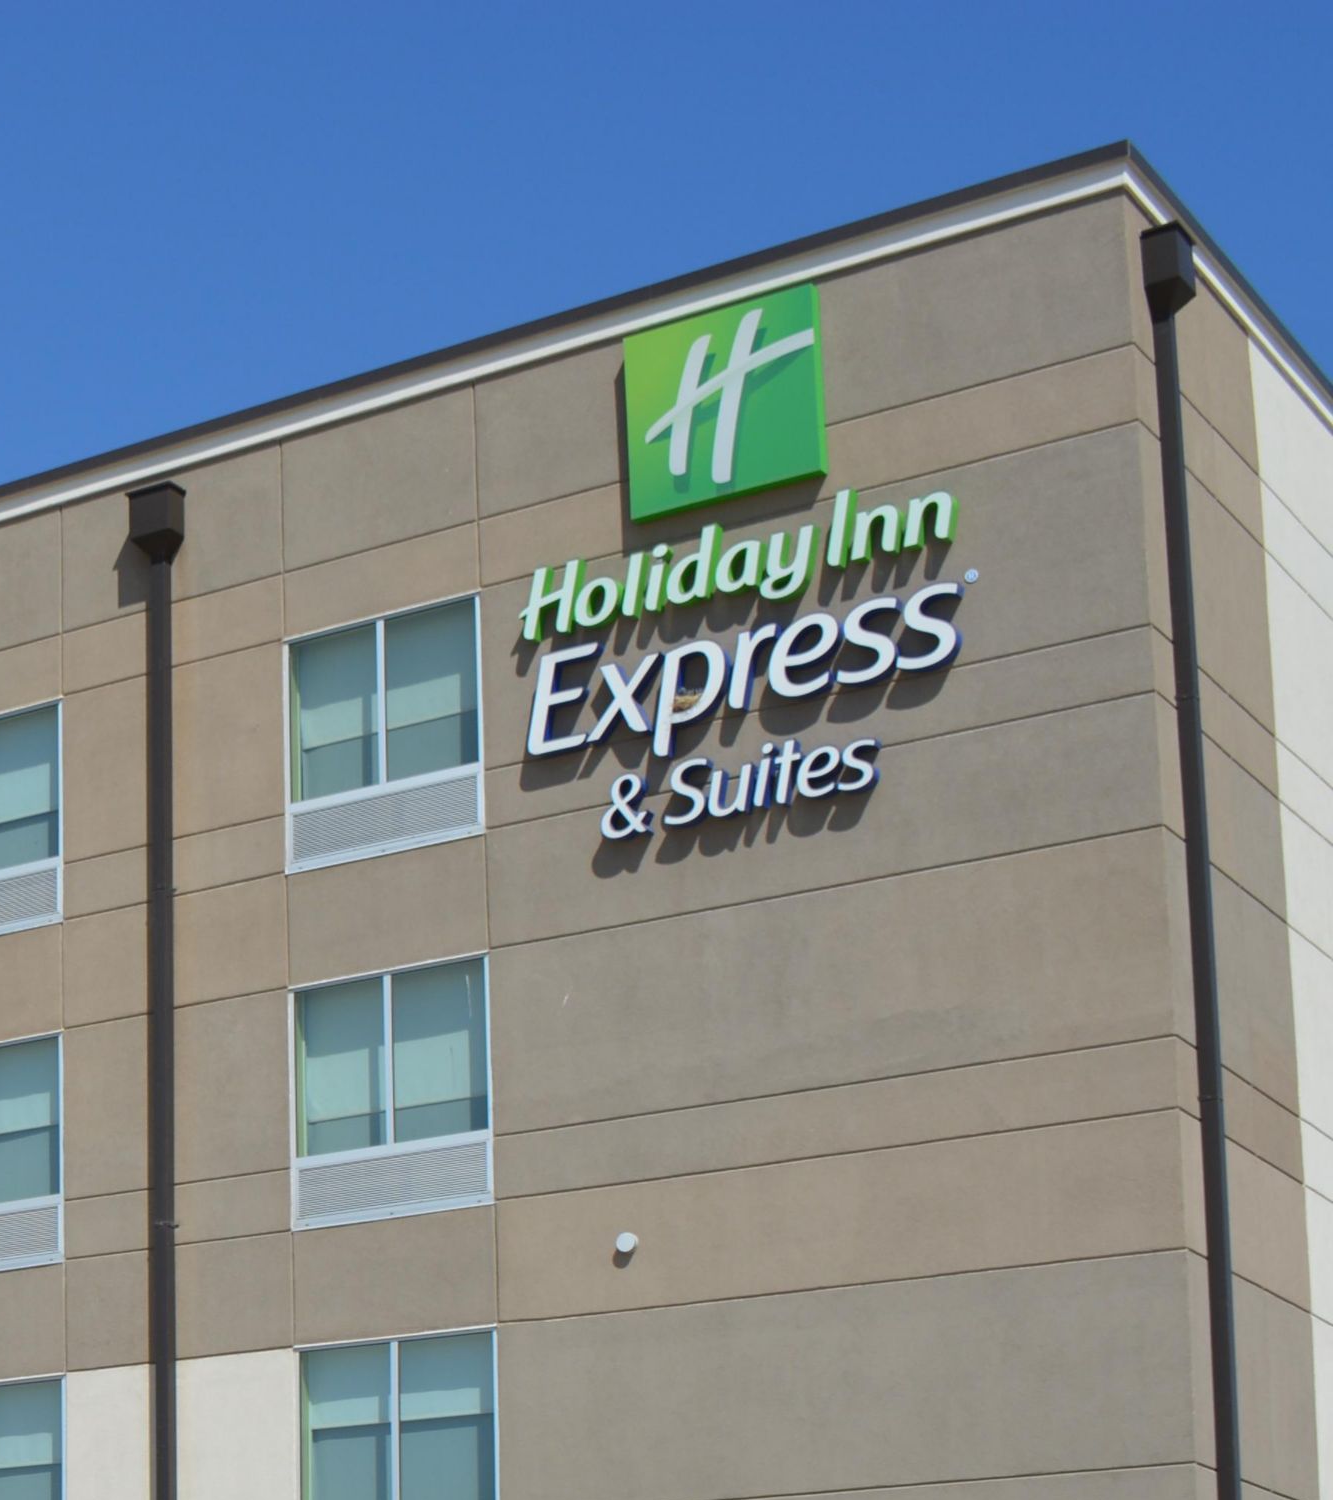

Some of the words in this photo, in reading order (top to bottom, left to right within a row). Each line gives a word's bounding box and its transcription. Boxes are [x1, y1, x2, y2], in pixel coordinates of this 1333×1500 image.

[519, 523, 818, 641] Holiday
[827, 489, 959, 568] Inn
[527, 582, 964, 757] Express
[600, 773, 654, 841] &
[664, 738, 881, 826] Suites
